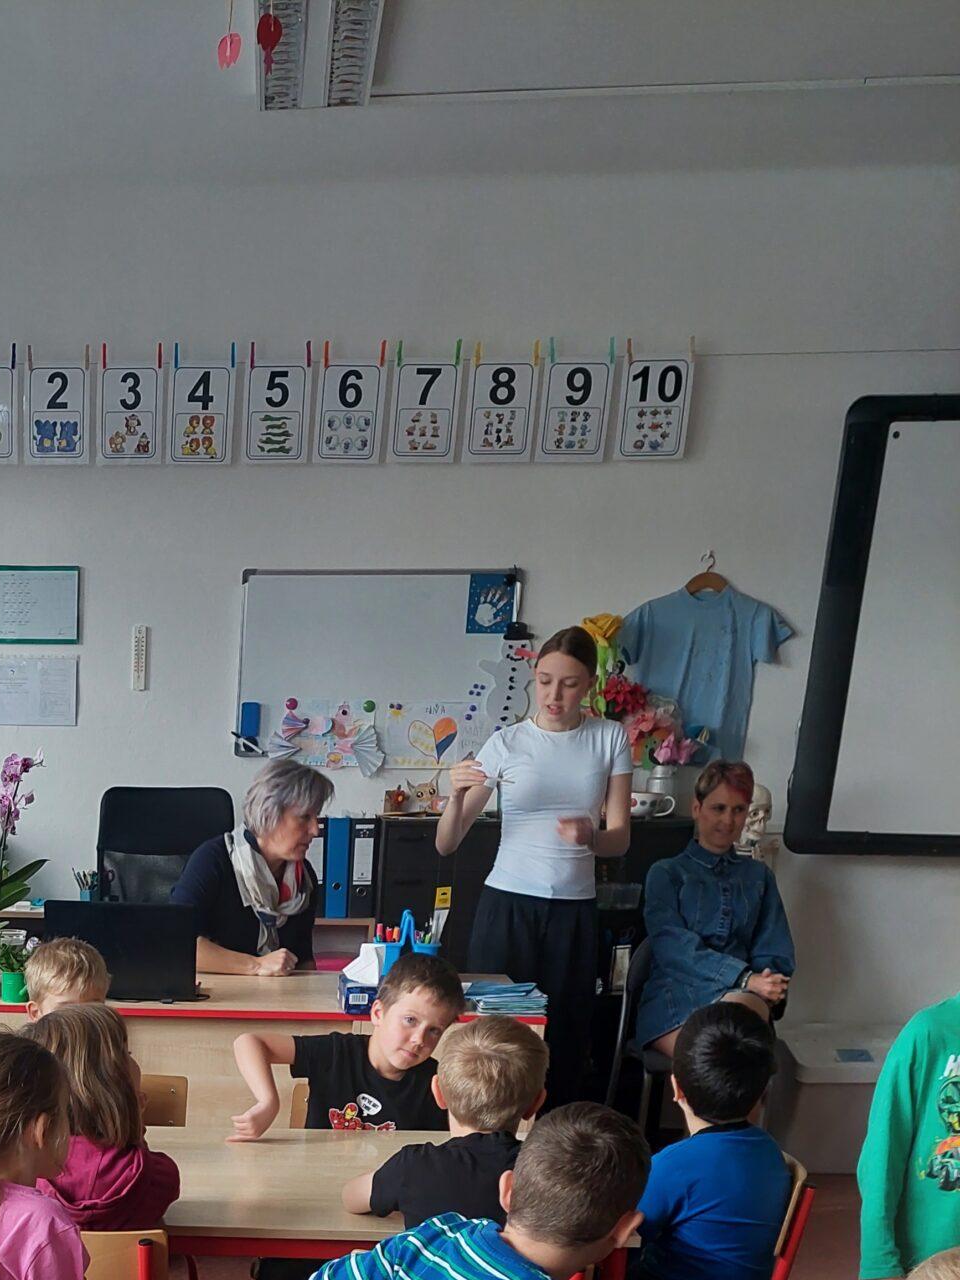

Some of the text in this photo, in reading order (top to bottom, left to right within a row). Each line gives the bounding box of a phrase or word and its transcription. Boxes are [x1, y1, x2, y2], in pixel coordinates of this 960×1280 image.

[46, 372, 68, 410] 2
[119, 372, 142, 410] 3
[187, 371, 214, 410] 4
[265, 371, 290, 408] 5
[338, 370, 363, 408] 6
[416, 368, 442, 406] 7
[489, 367, 516, 406] 8
[565, 367, 593, 406] 9
[632, 365, 683, 403] 10
